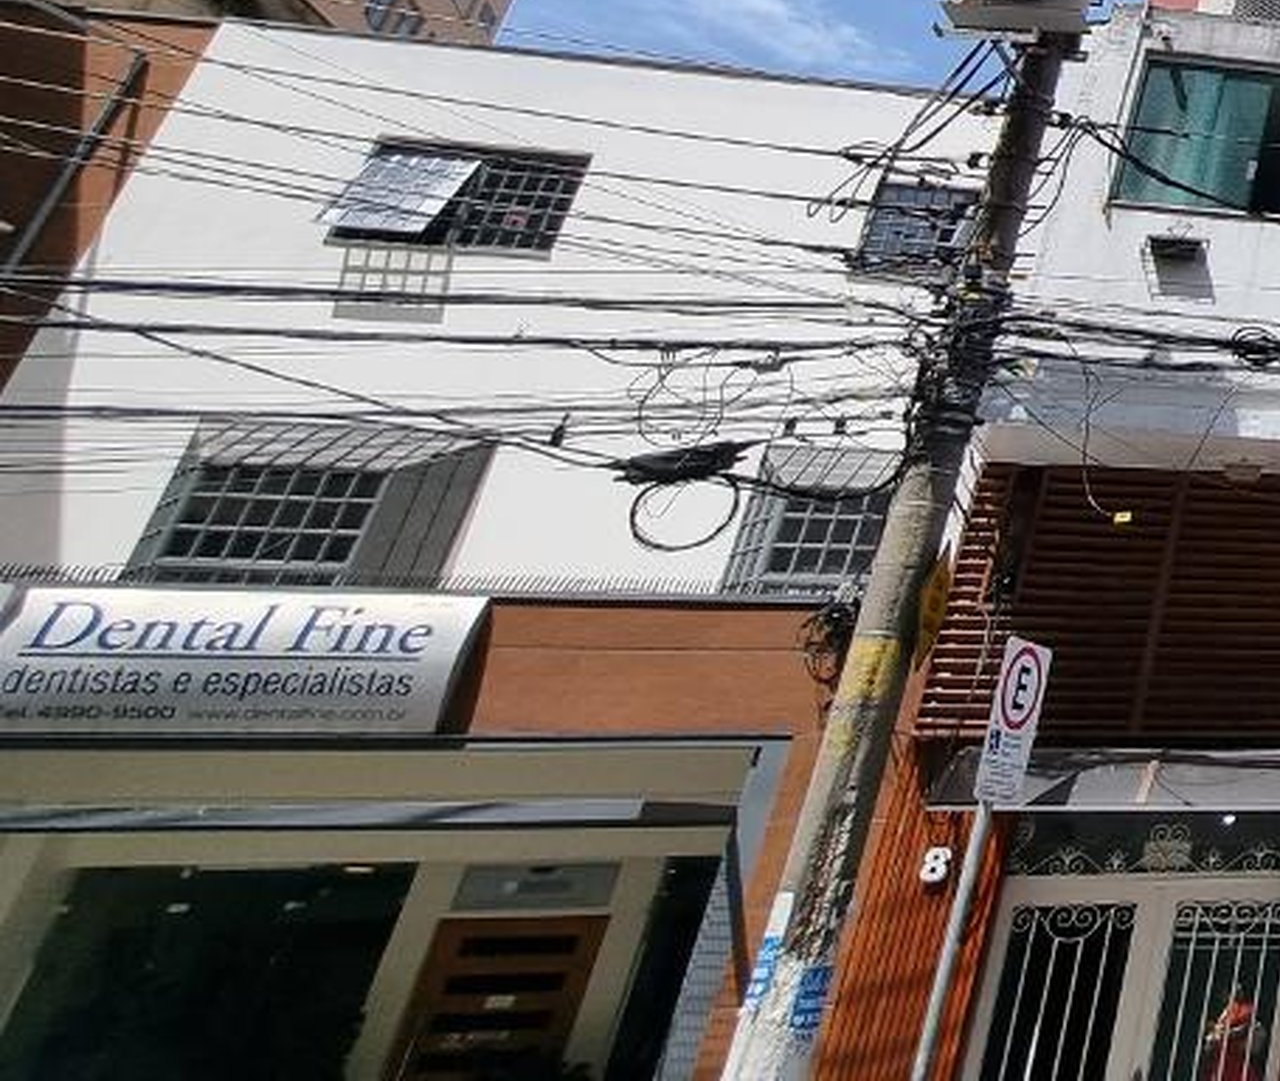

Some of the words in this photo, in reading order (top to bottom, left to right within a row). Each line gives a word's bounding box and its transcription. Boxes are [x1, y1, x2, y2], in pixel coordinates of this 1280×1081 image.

[23, 601, 281, 651] Dental
[285, 604, 433, 655] Fine
[3, 664, 162, 695] dentistas
[173, 671, 192, 695] e
[202, 667, 413, 701] especialistas
[1011, 665, 1031, 710] E
[919, 846, 952, 882] 8
